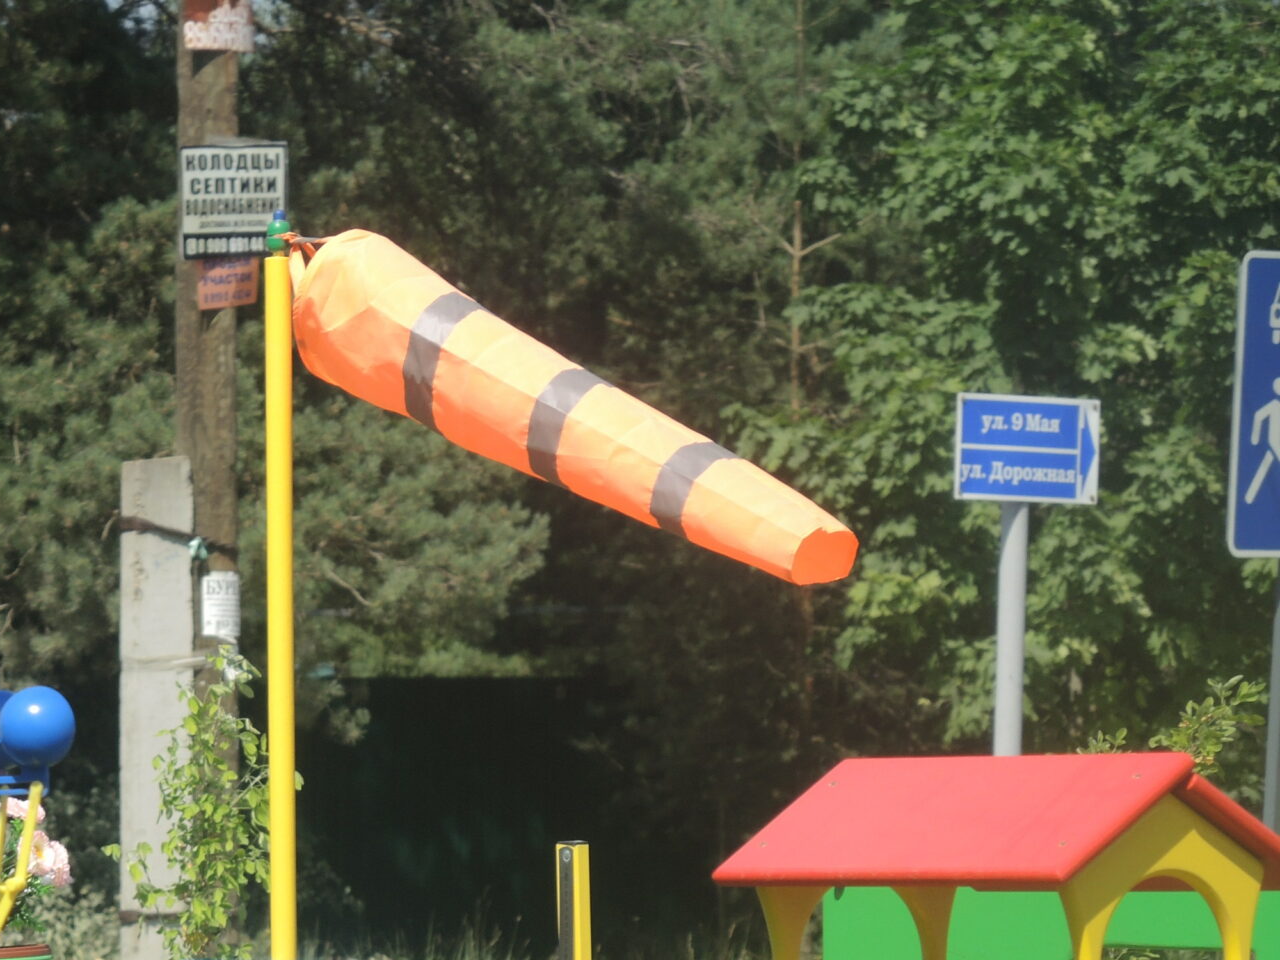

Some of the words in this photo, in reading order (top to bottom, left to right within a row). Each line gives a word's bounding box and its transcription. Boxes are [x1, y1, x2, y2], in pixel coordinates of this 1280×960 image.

[186, 153, 280, 173] КОЛОДЦЫ
[190, 176, 277, 195] СЕПТИКИ
[981, 414, 1008, 434] ул.
[1011, 412, 1024, 432] 9
[1025, 413, 1061, 433] Мая
[961, 463, 987, 482] ул.
[988, 461, 1075, 486] Дорожная
